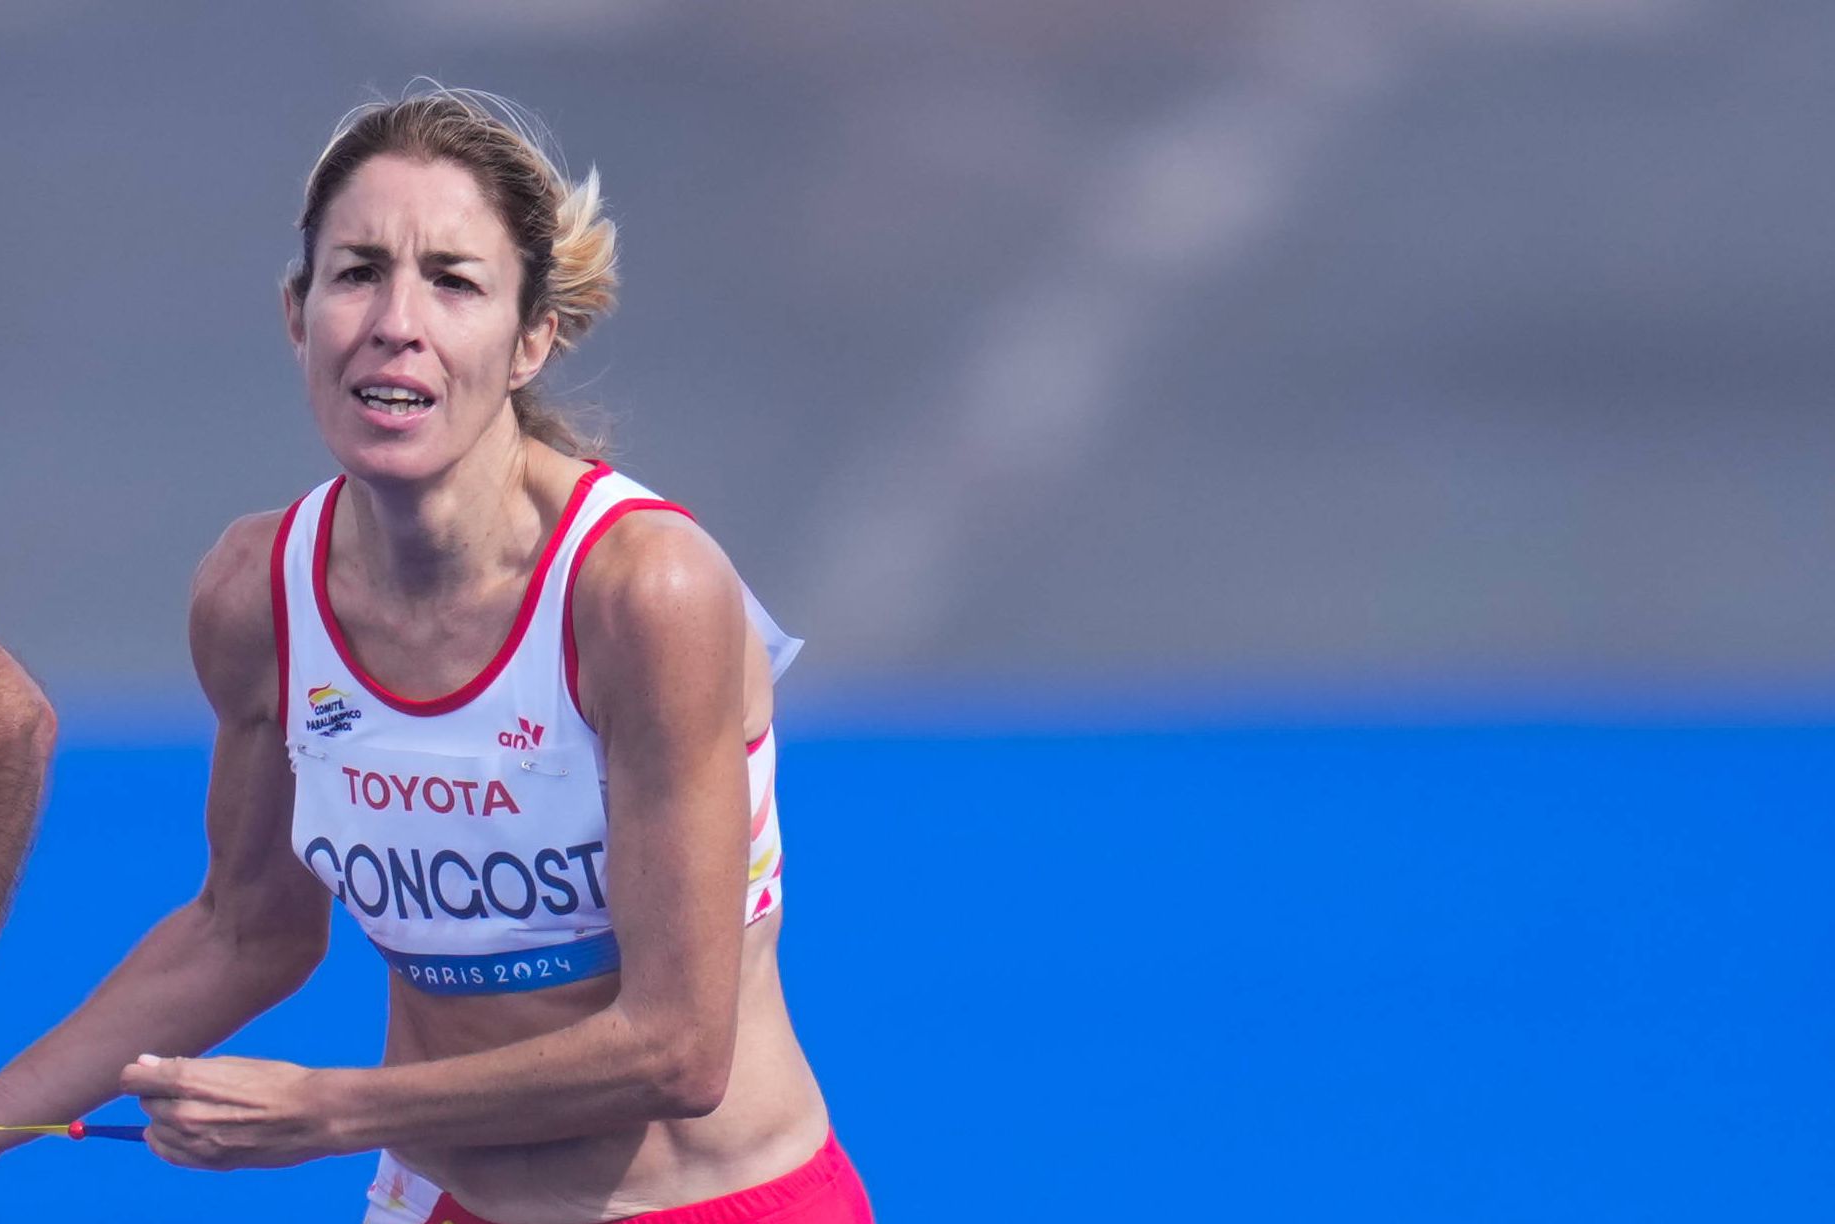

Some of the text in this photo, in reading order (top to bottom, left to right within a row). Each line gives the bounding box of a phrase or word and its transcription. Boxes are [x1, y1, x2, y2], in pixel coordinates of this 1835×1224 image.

[342, 766, 522, 817] TOYOTA
[304, 836, 607, 921] CONGOST
[409, 956, 572, 985] PARIS 2024
